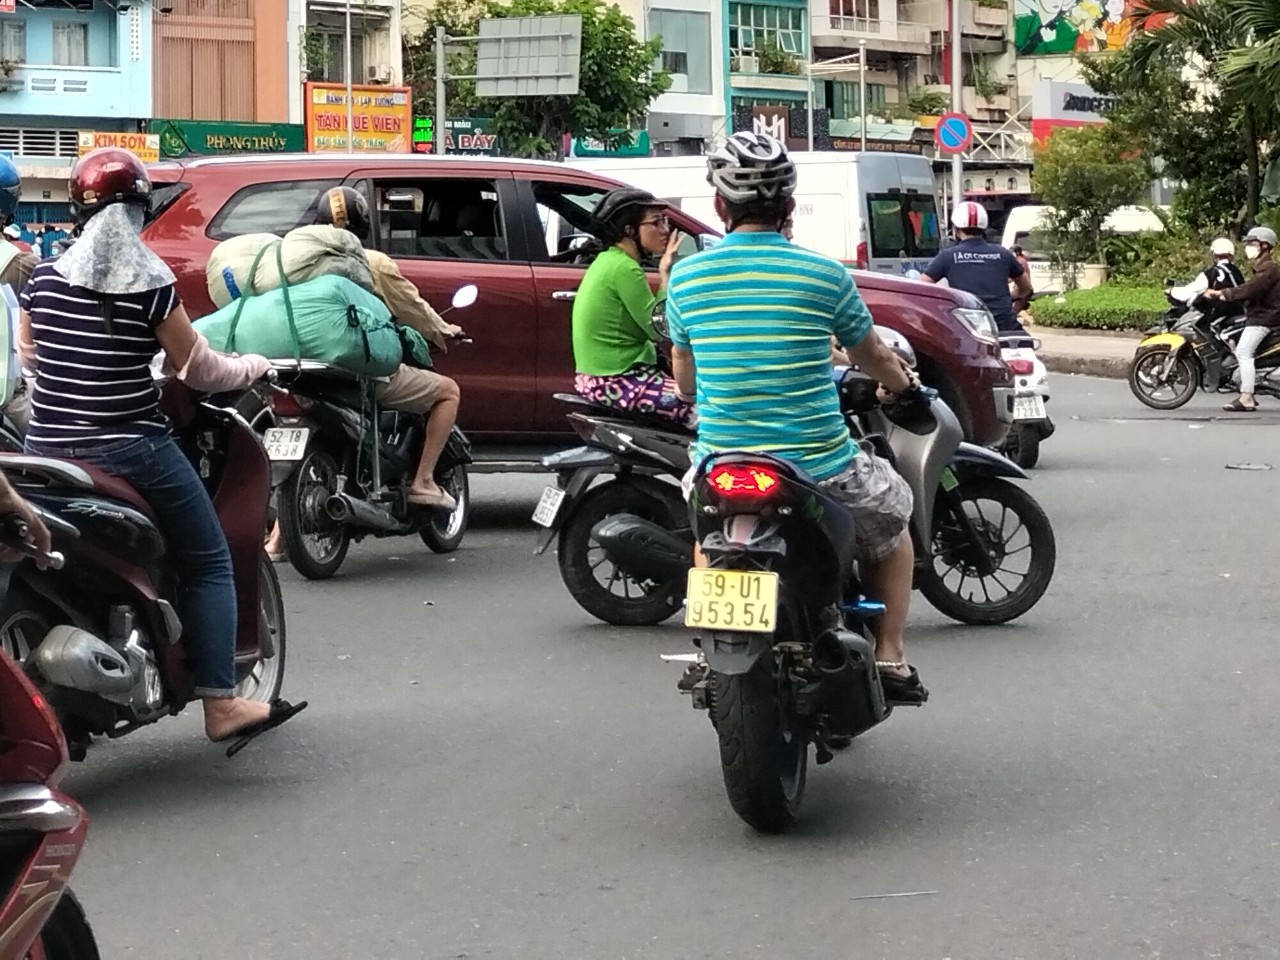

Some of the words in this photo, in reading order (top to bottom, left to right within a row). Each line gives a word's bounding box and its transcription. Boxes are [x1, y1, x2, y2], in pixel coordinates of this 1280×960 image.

[94, 134, 120, 148] KIM
[206, 134, 251, 150] PHONG
[702, 573, 761, 600] 59-U1
